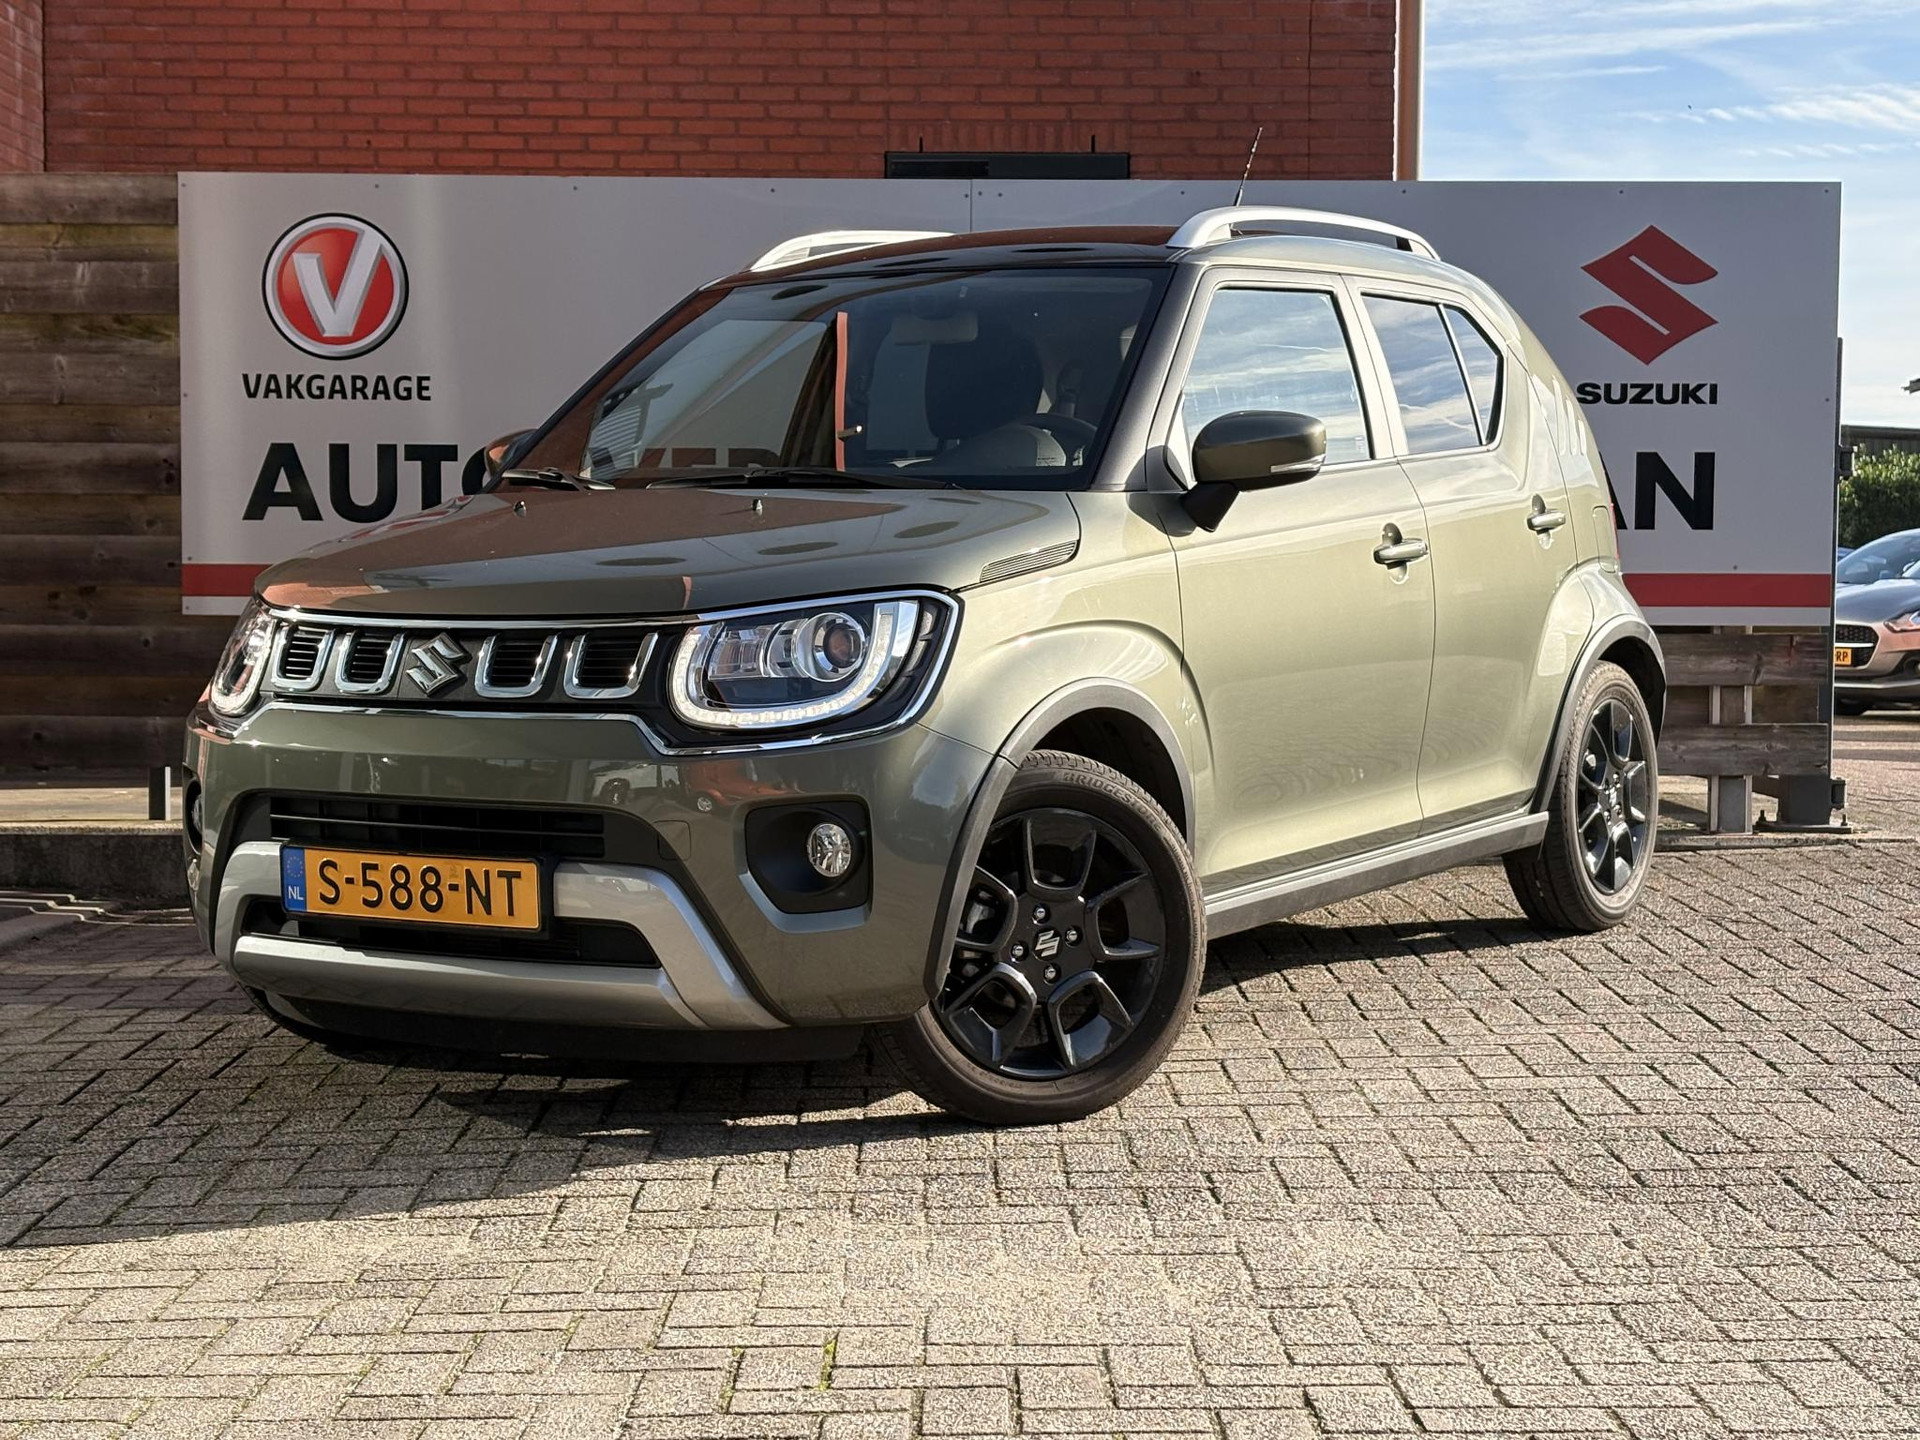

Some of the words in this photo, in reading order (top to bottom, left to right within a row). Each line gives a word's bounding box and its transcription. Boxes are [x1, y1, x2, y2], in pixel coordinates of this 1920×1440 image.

[241, 373, 432, 401] VAKGARAGE
[1576, 382, 1718, 405] SUZUKI
[1599, 451, 1716, 530] N
[1836, 651, 1849, 662] RP
[287, 885, 304, 901] NL
[318, 859, 523, 917] S-588-NT
